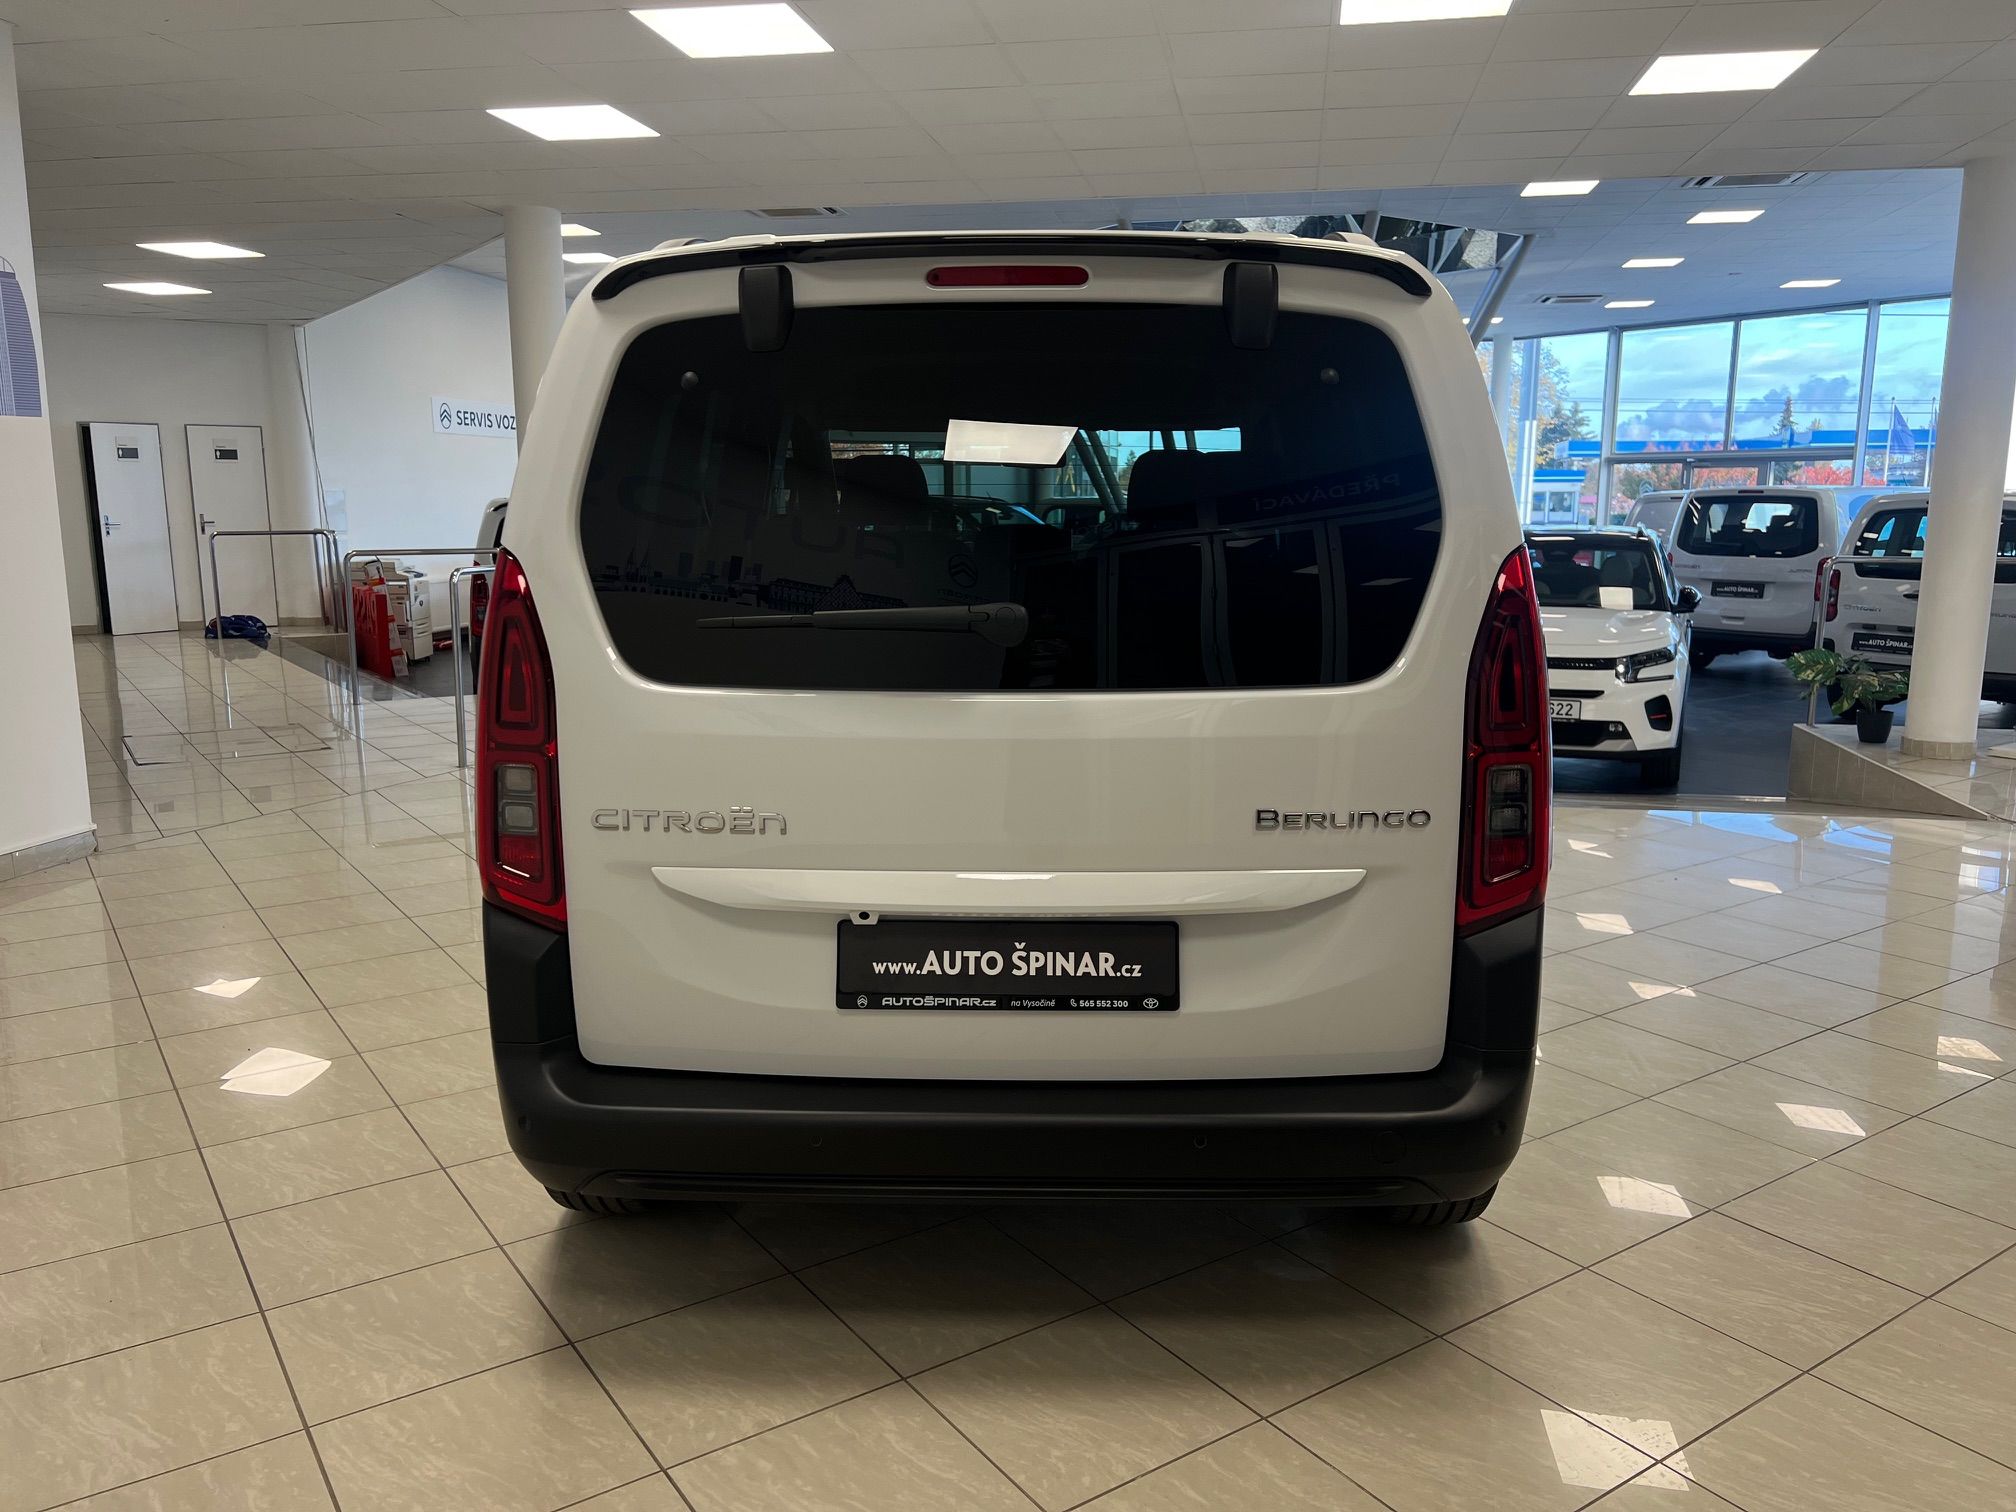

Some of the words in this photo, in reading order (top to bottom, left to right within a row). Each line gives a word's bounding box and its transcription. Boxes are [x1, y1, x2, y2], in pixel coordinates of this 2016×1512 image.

[456, 410, 493, 428] SERVIS
[591, 806, 787, 835] CITROËN
[872, 950, 1004, 976] www.AUTO
[1011, 942, 1142, 977] ŠPINAR.cz
[1022, 999, 1056, 1009] Vysočině
[1079, 1000, 1095, 1008] 565
[1096, 1000, 1112, 1008] 552
[1113, 1000, 1129, 1008] 300
